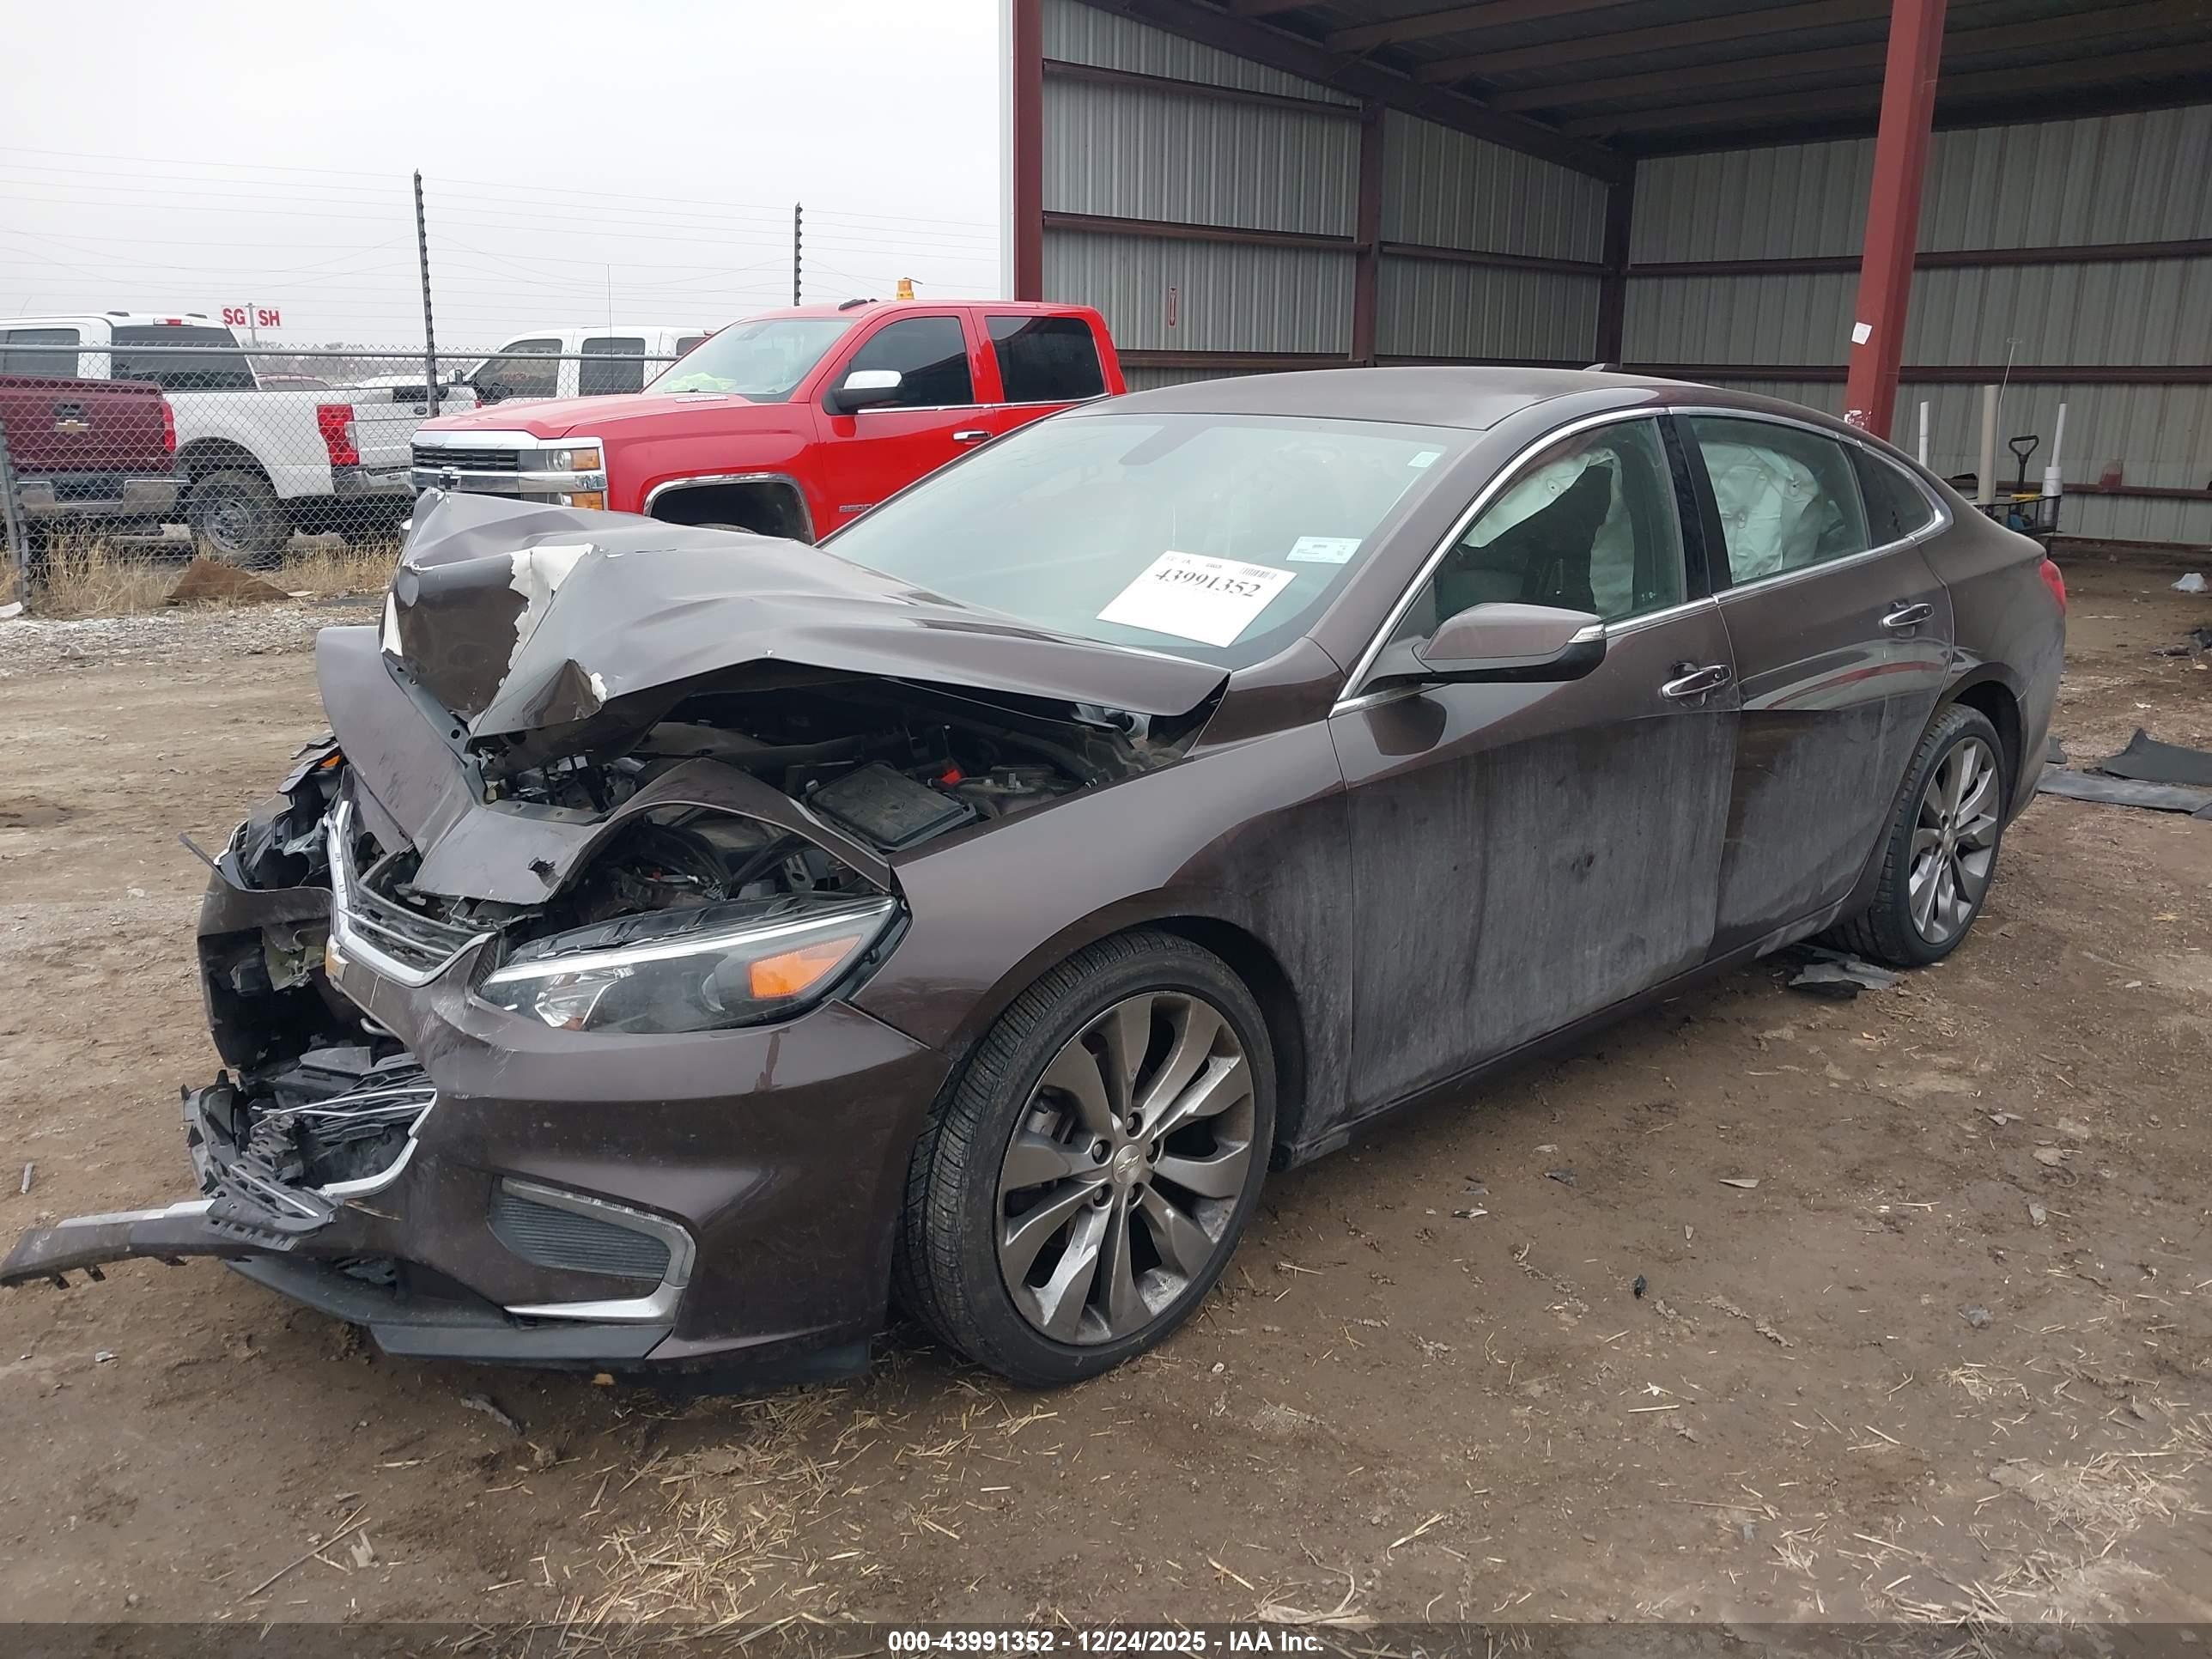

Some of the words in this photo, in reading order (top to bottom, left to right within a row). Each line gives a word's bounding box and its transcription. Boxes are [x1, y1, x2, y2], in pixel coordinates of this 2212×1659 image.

[222, 307, 246, 325] SG
[258, 309, 280, 326] SH
[1155, 568, 1261, 598] 43991352
